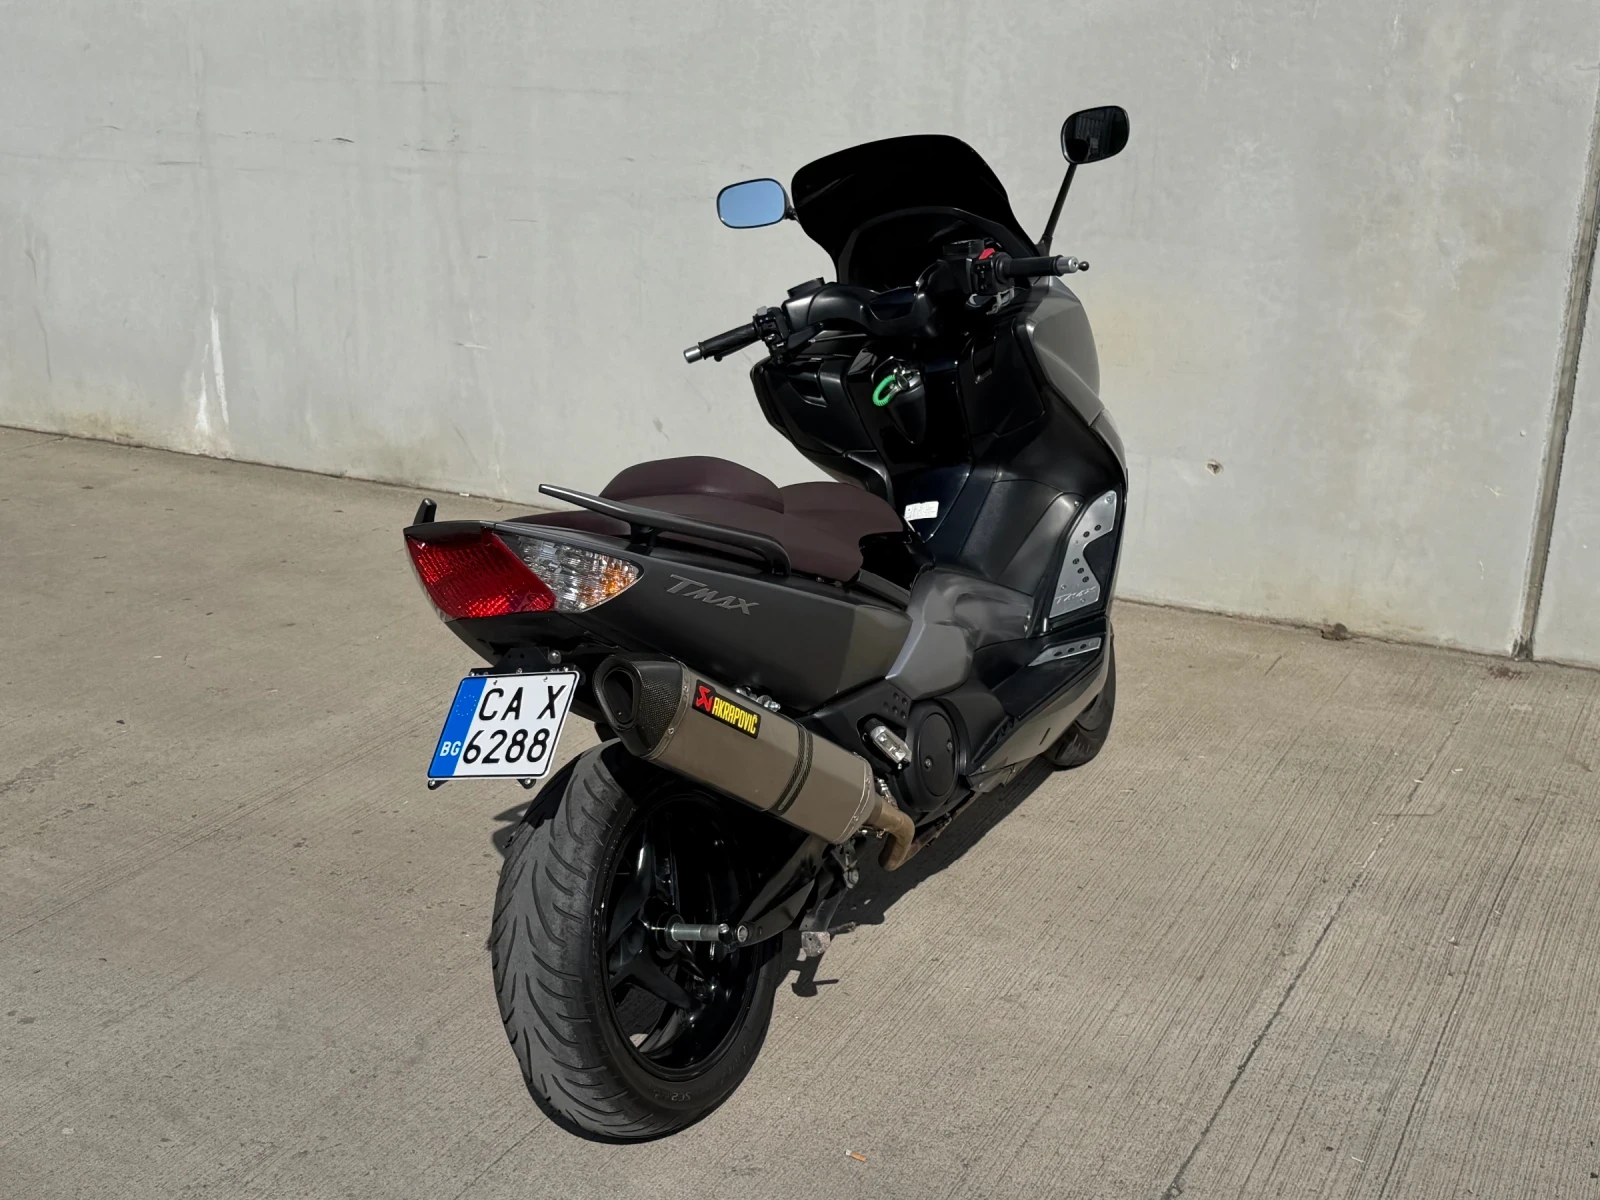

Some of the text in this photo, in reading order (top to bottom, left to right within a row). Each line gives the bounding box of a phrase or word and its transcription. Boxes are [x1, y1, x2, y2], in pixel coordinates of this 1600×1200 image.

[666, 574, 760, 615] TMAX
[479, 685, 567, 721] CA X
[440, 741, 462, 757] BG
[463, 728, 551, 764] 6288
